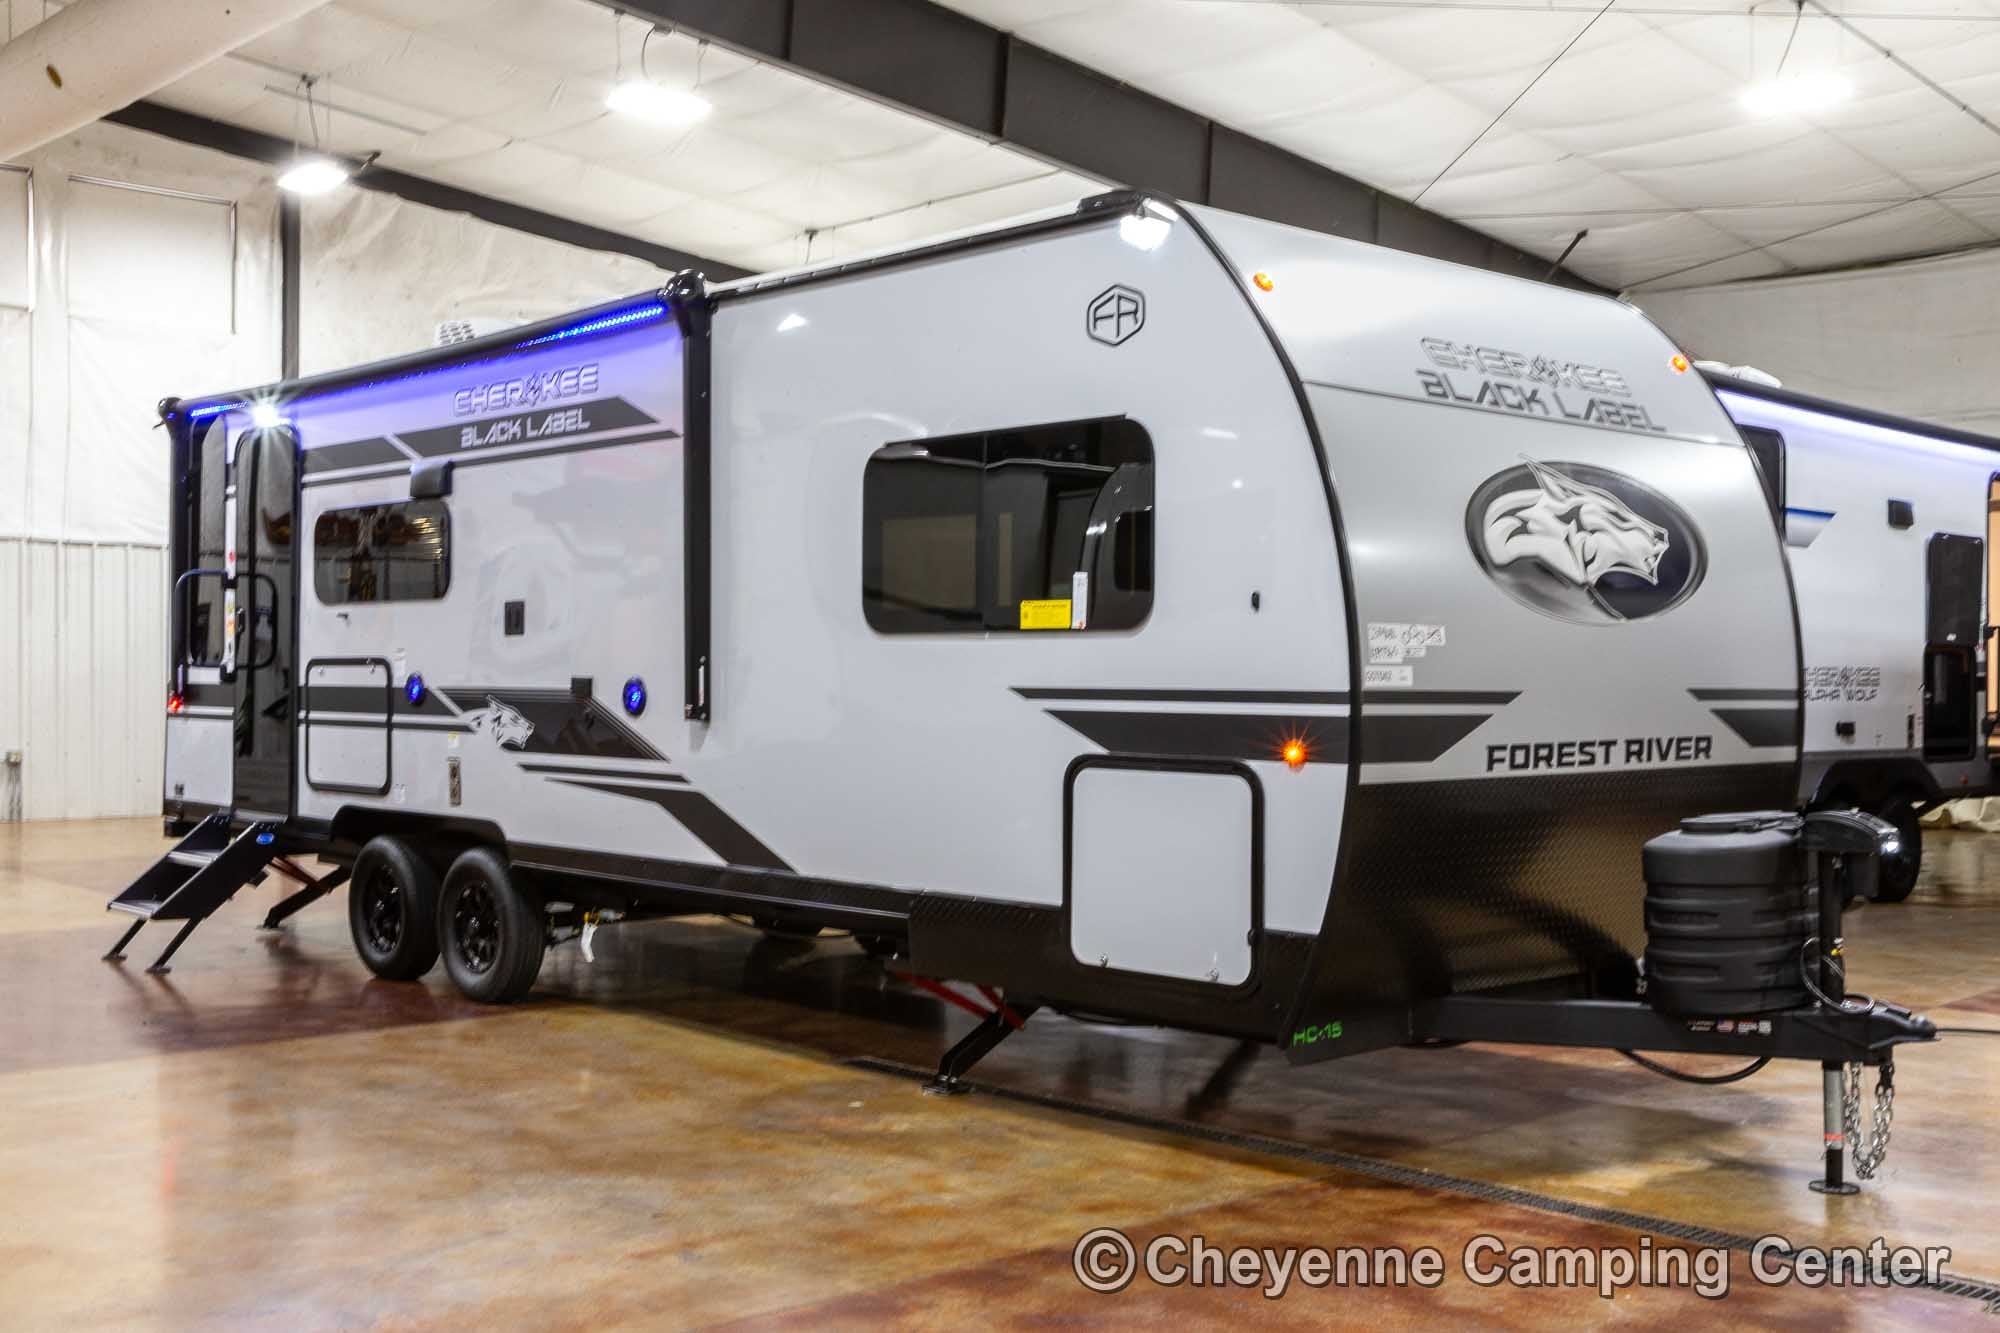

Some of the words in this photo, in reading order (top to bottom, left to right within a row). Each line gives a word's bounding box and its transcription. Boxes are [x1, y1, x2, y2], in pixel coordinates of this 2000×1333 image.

[1415, 368, 1550, 416] BLACK
[1552, 390, 1667, 433] LABEL
[460, 417, 522, 449] BLACK
[526, 407, 591, 439] LABEL
[1485, 738, 1618, 772] FOREST
[1624, 734, 1713, 765] RIVER
